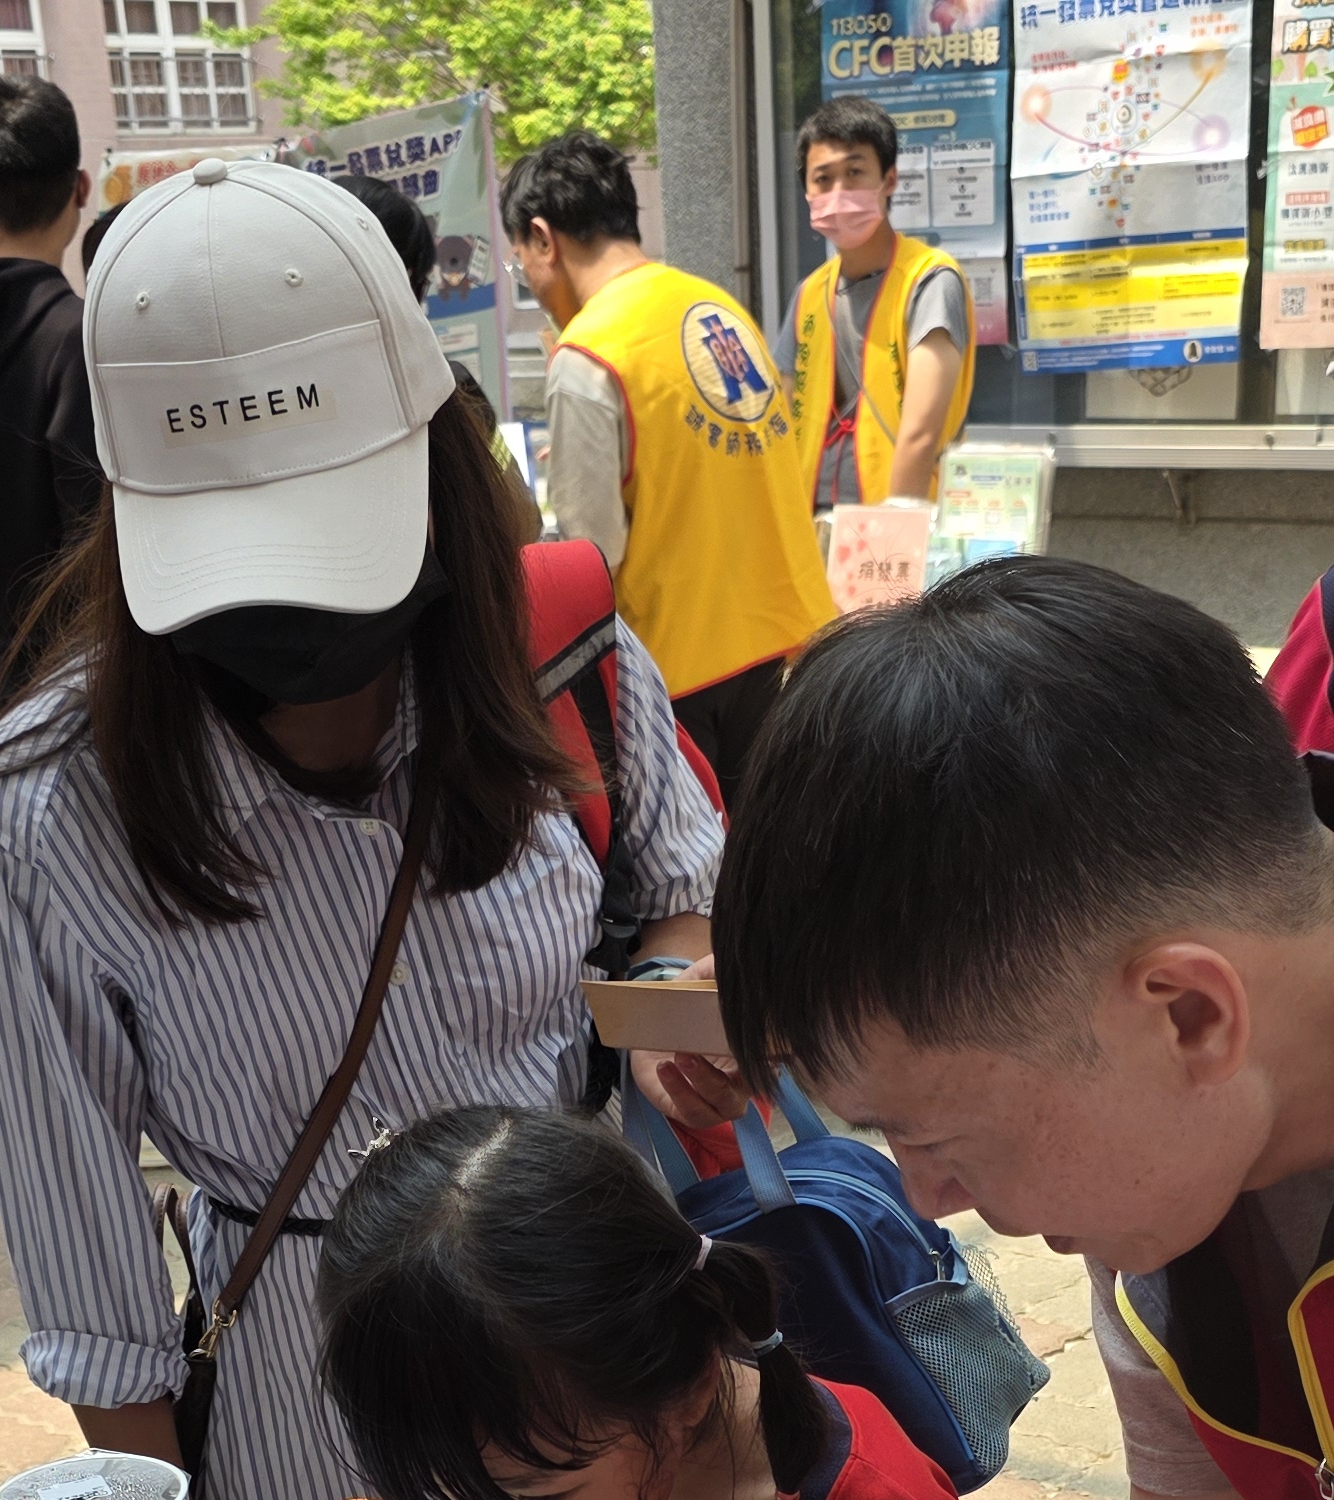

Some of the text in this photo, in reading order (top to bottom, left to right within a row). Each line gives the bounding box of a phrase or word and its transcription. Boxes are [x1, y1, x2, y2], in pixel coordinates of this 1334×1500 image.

[829, 27, 1000, 78] CFC首次申報
[166, 383, 320, 433] ESTEEM
